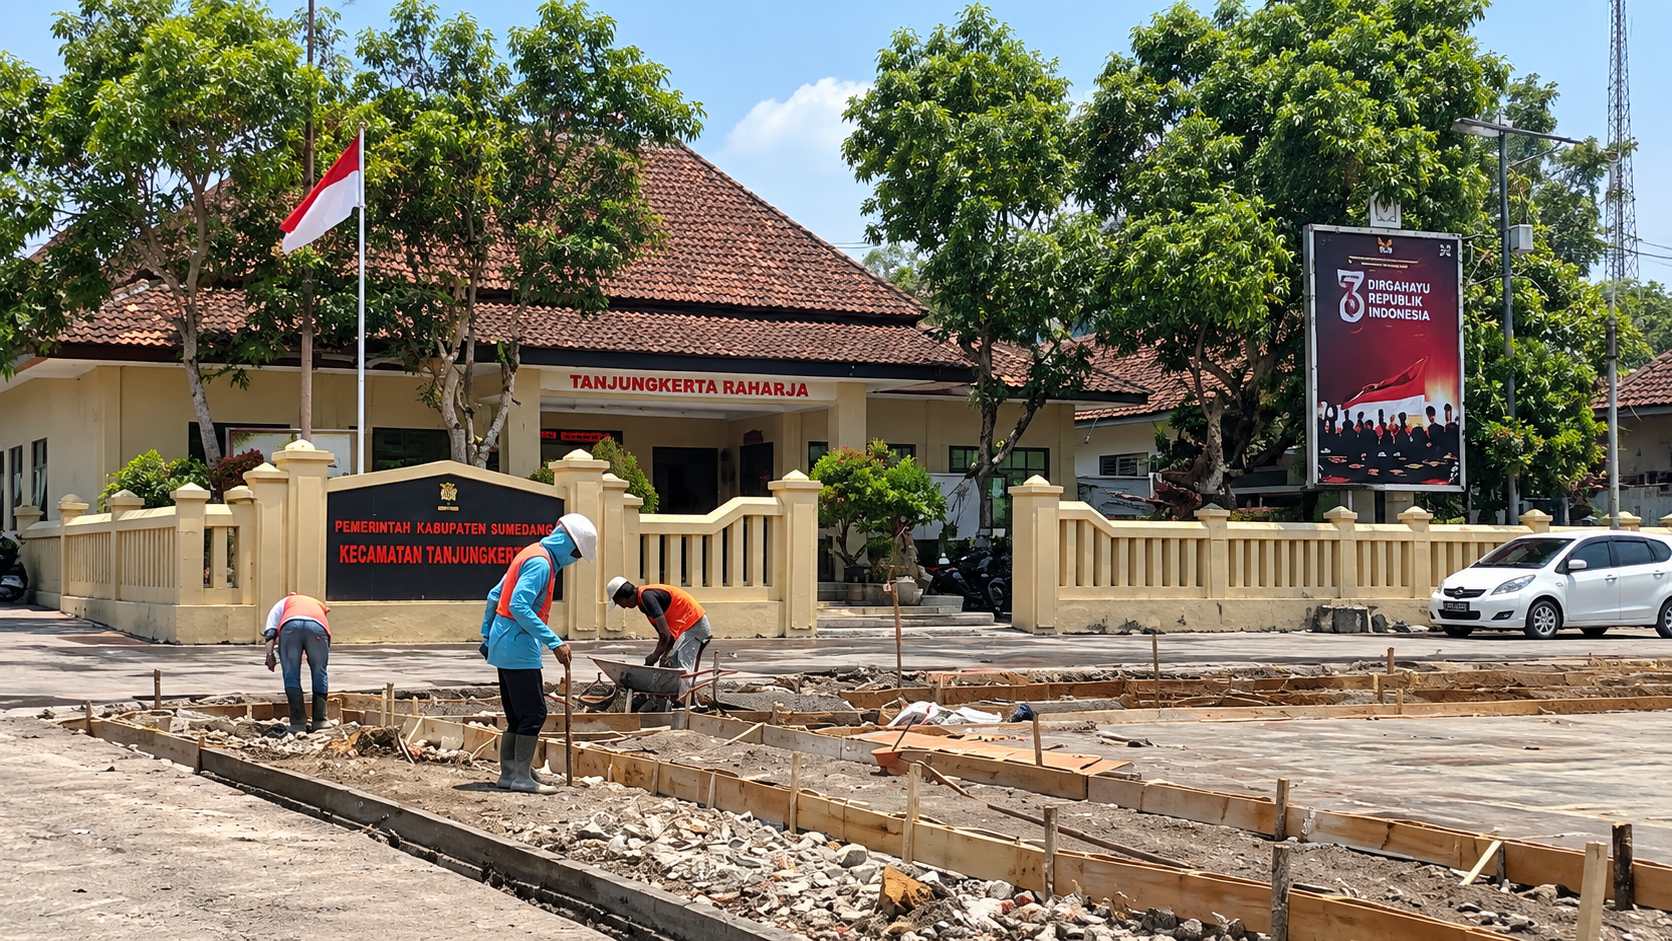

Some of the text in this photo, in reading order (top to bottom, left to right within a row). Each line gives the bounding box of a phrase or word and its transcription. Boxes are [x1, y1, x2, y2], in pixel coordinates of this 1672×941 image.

[1368, 279, 1430, 294] DIRGAHAYU
[1368, 293, 1422, 307] REPUBLIK
[1368, 306, 1430, 321] INDONESIA
[570, 374, 809, 397] TANJUNGKERTA RAHARJA
[335, 520, 553, 536] PEMERINTAH KABUPATEN SUMEDANG
[339, 544, 523, 565] KECAMATAN TANJUNGKER
